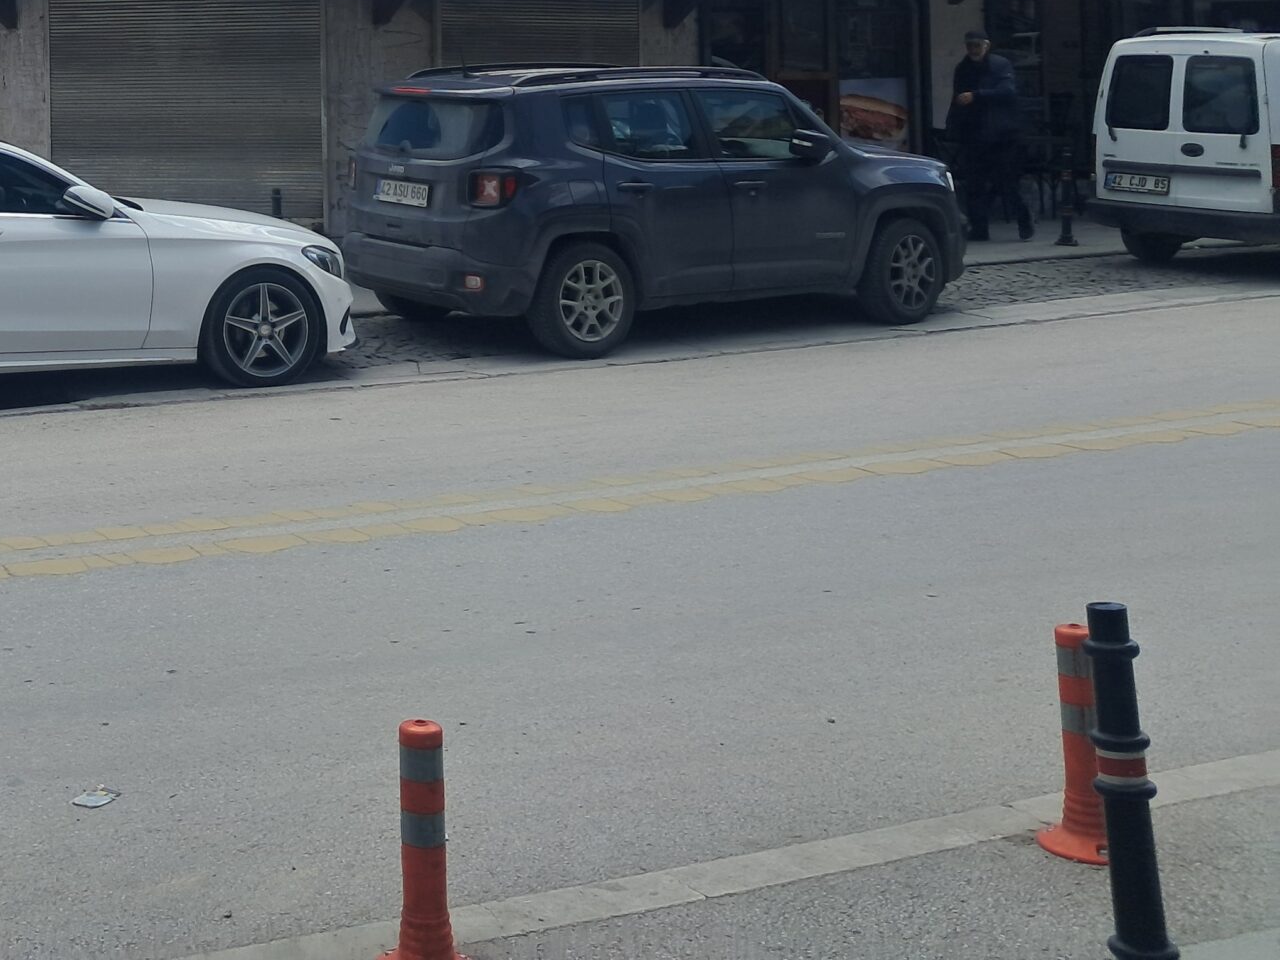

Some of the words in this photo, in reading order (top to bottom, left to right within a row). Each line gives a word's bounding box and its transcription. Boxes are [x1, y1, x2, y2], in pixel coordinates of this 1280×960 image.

[1112, 174, 1123, 186] 42
[1129, 176, 1147, 188] CJD
[381, 181, 391, 195] 42
[393, 183, 409, 198] ASU
[410, 185, 427, 200] 660
